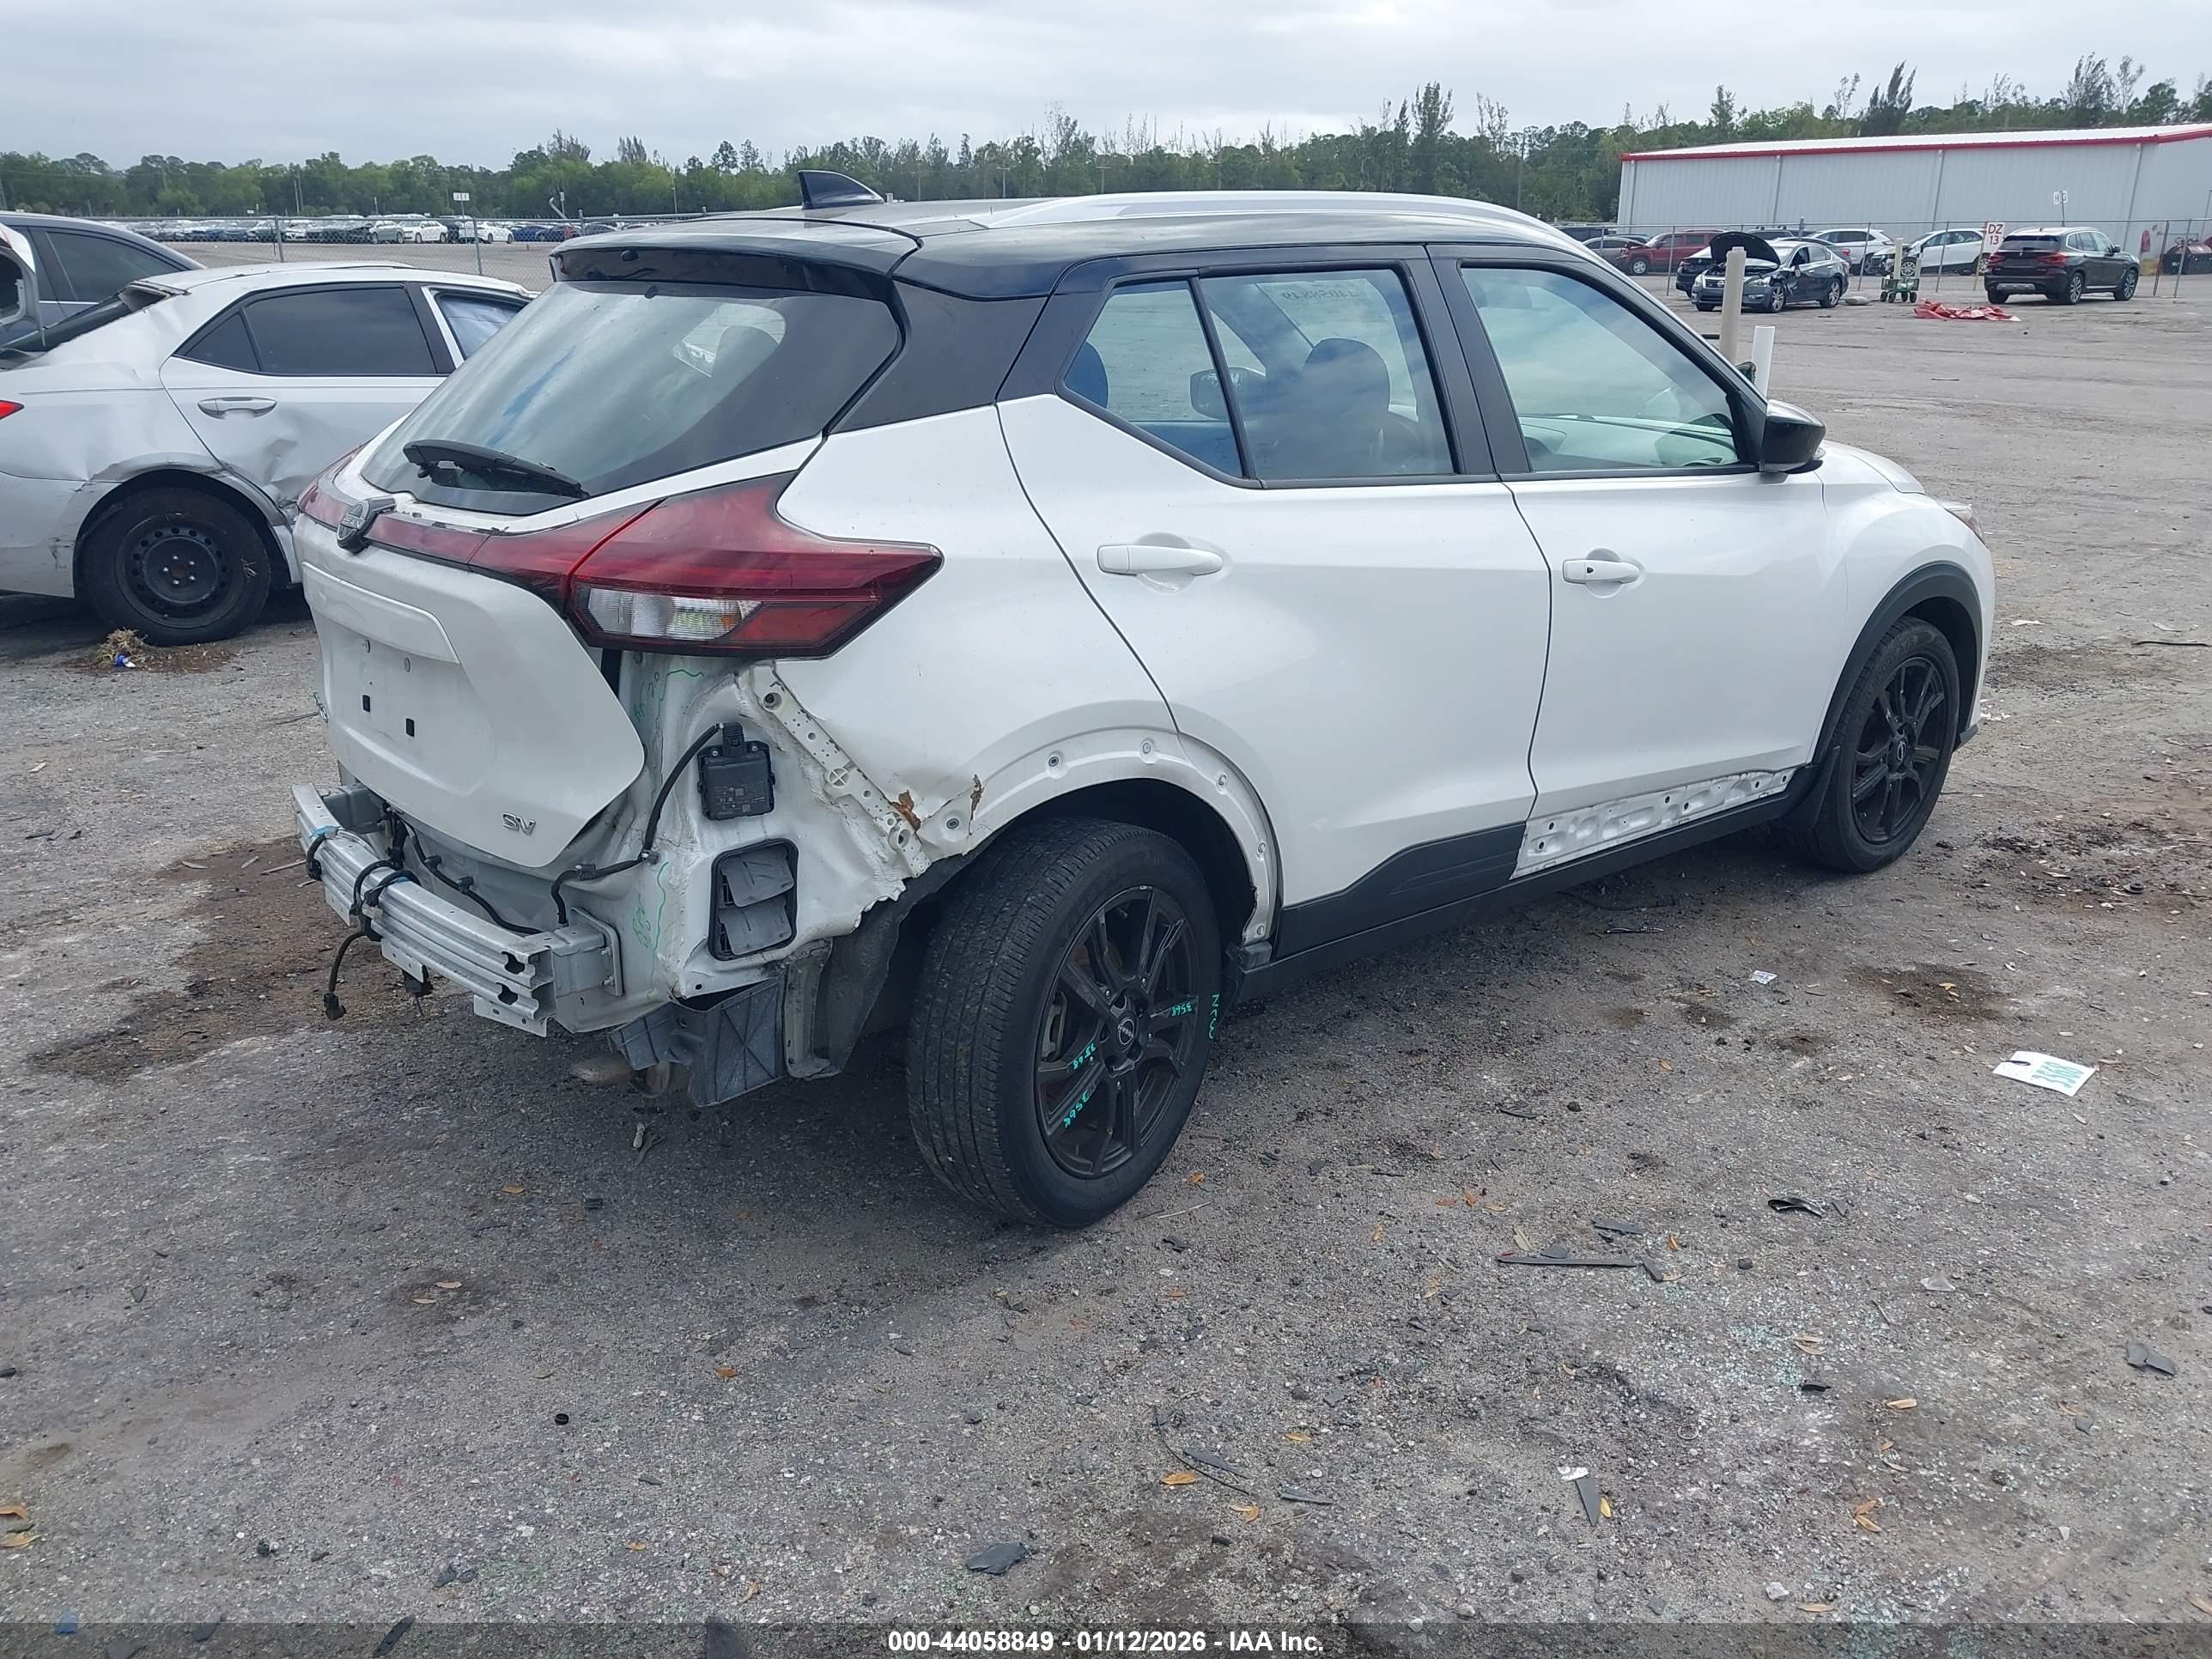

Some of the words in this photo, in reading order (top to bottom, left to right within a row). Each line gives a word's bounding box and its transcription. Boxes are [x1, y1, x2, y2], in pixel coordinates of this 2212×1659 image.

[1988, 223, 2003, 234] DZ
[1989, 234, 2000, 246] 13
[501, 812, 537, 836] SV
